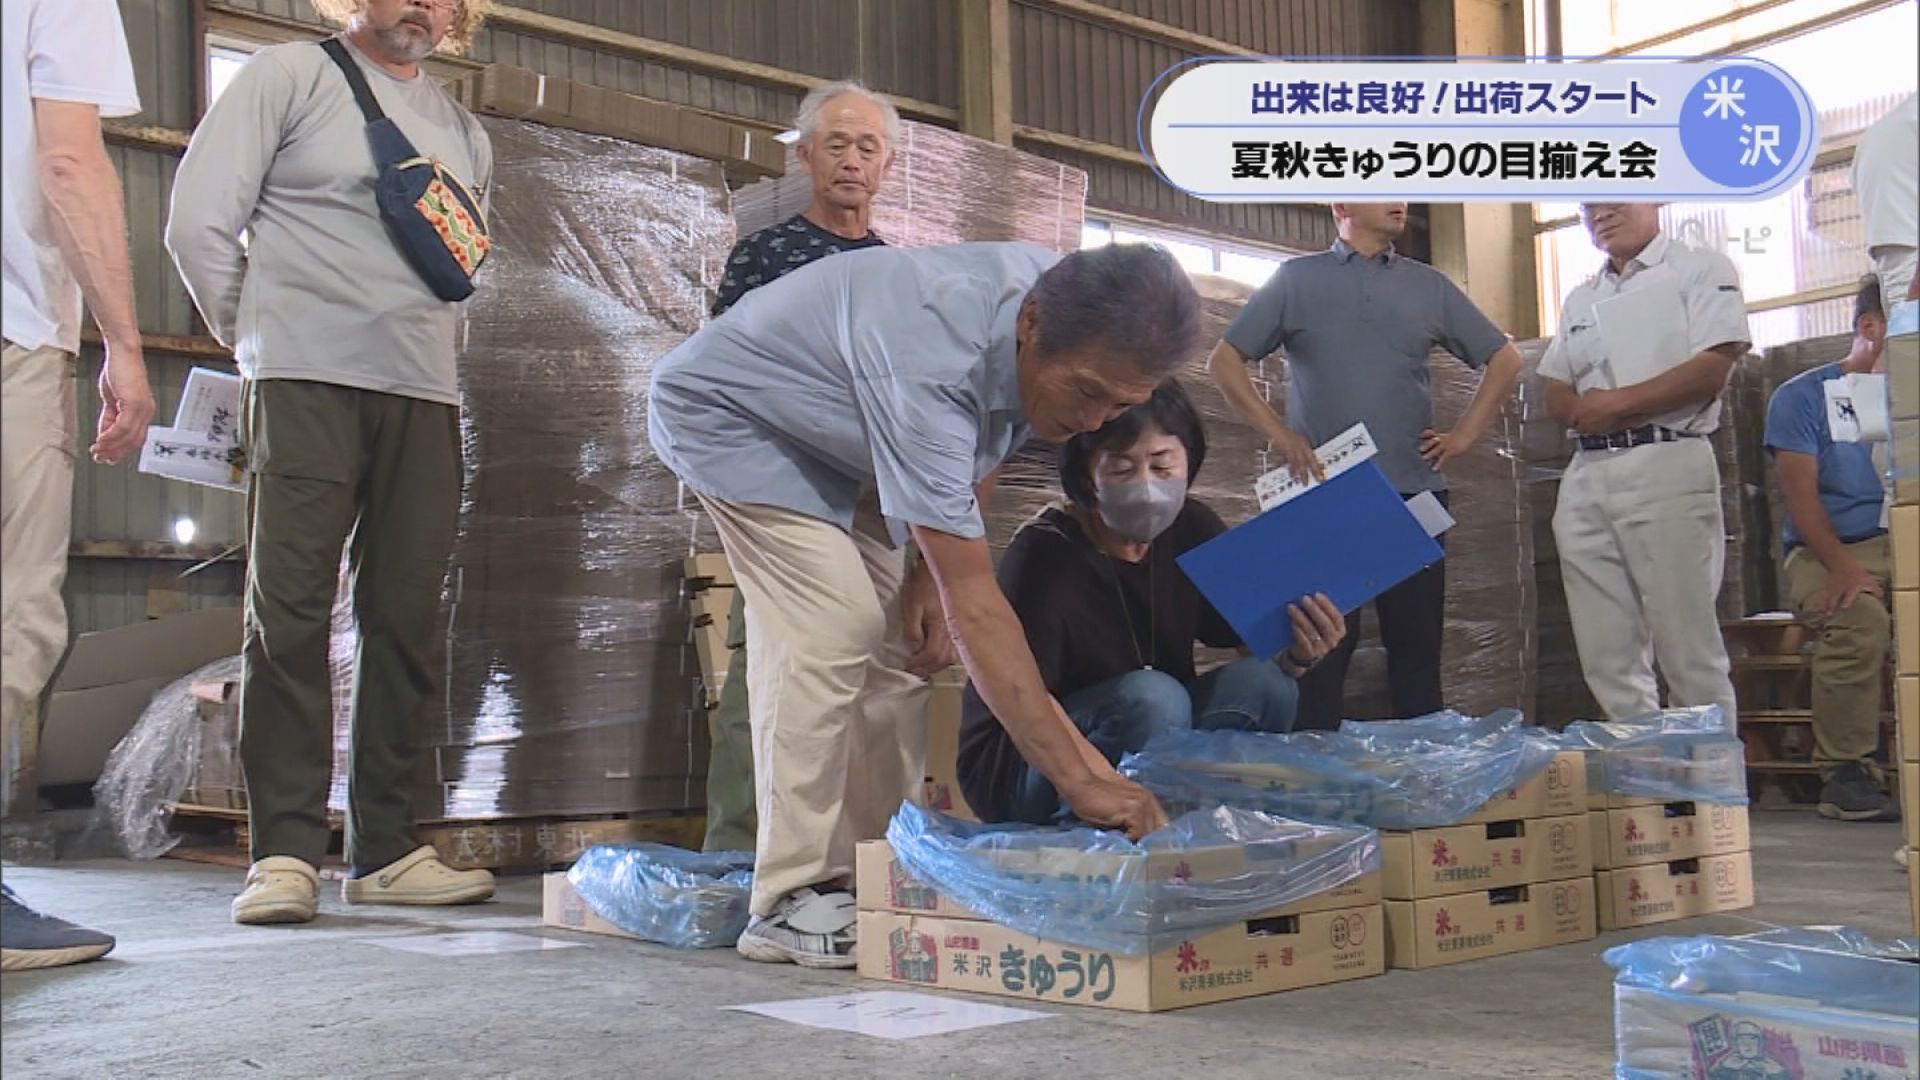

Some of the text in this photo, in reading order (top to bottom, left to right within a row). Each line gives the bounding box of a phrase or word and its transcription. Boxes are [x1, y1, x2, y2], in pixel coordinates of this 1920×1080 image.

[953, 943, 1115, 1002] 米沢 きゅうり
